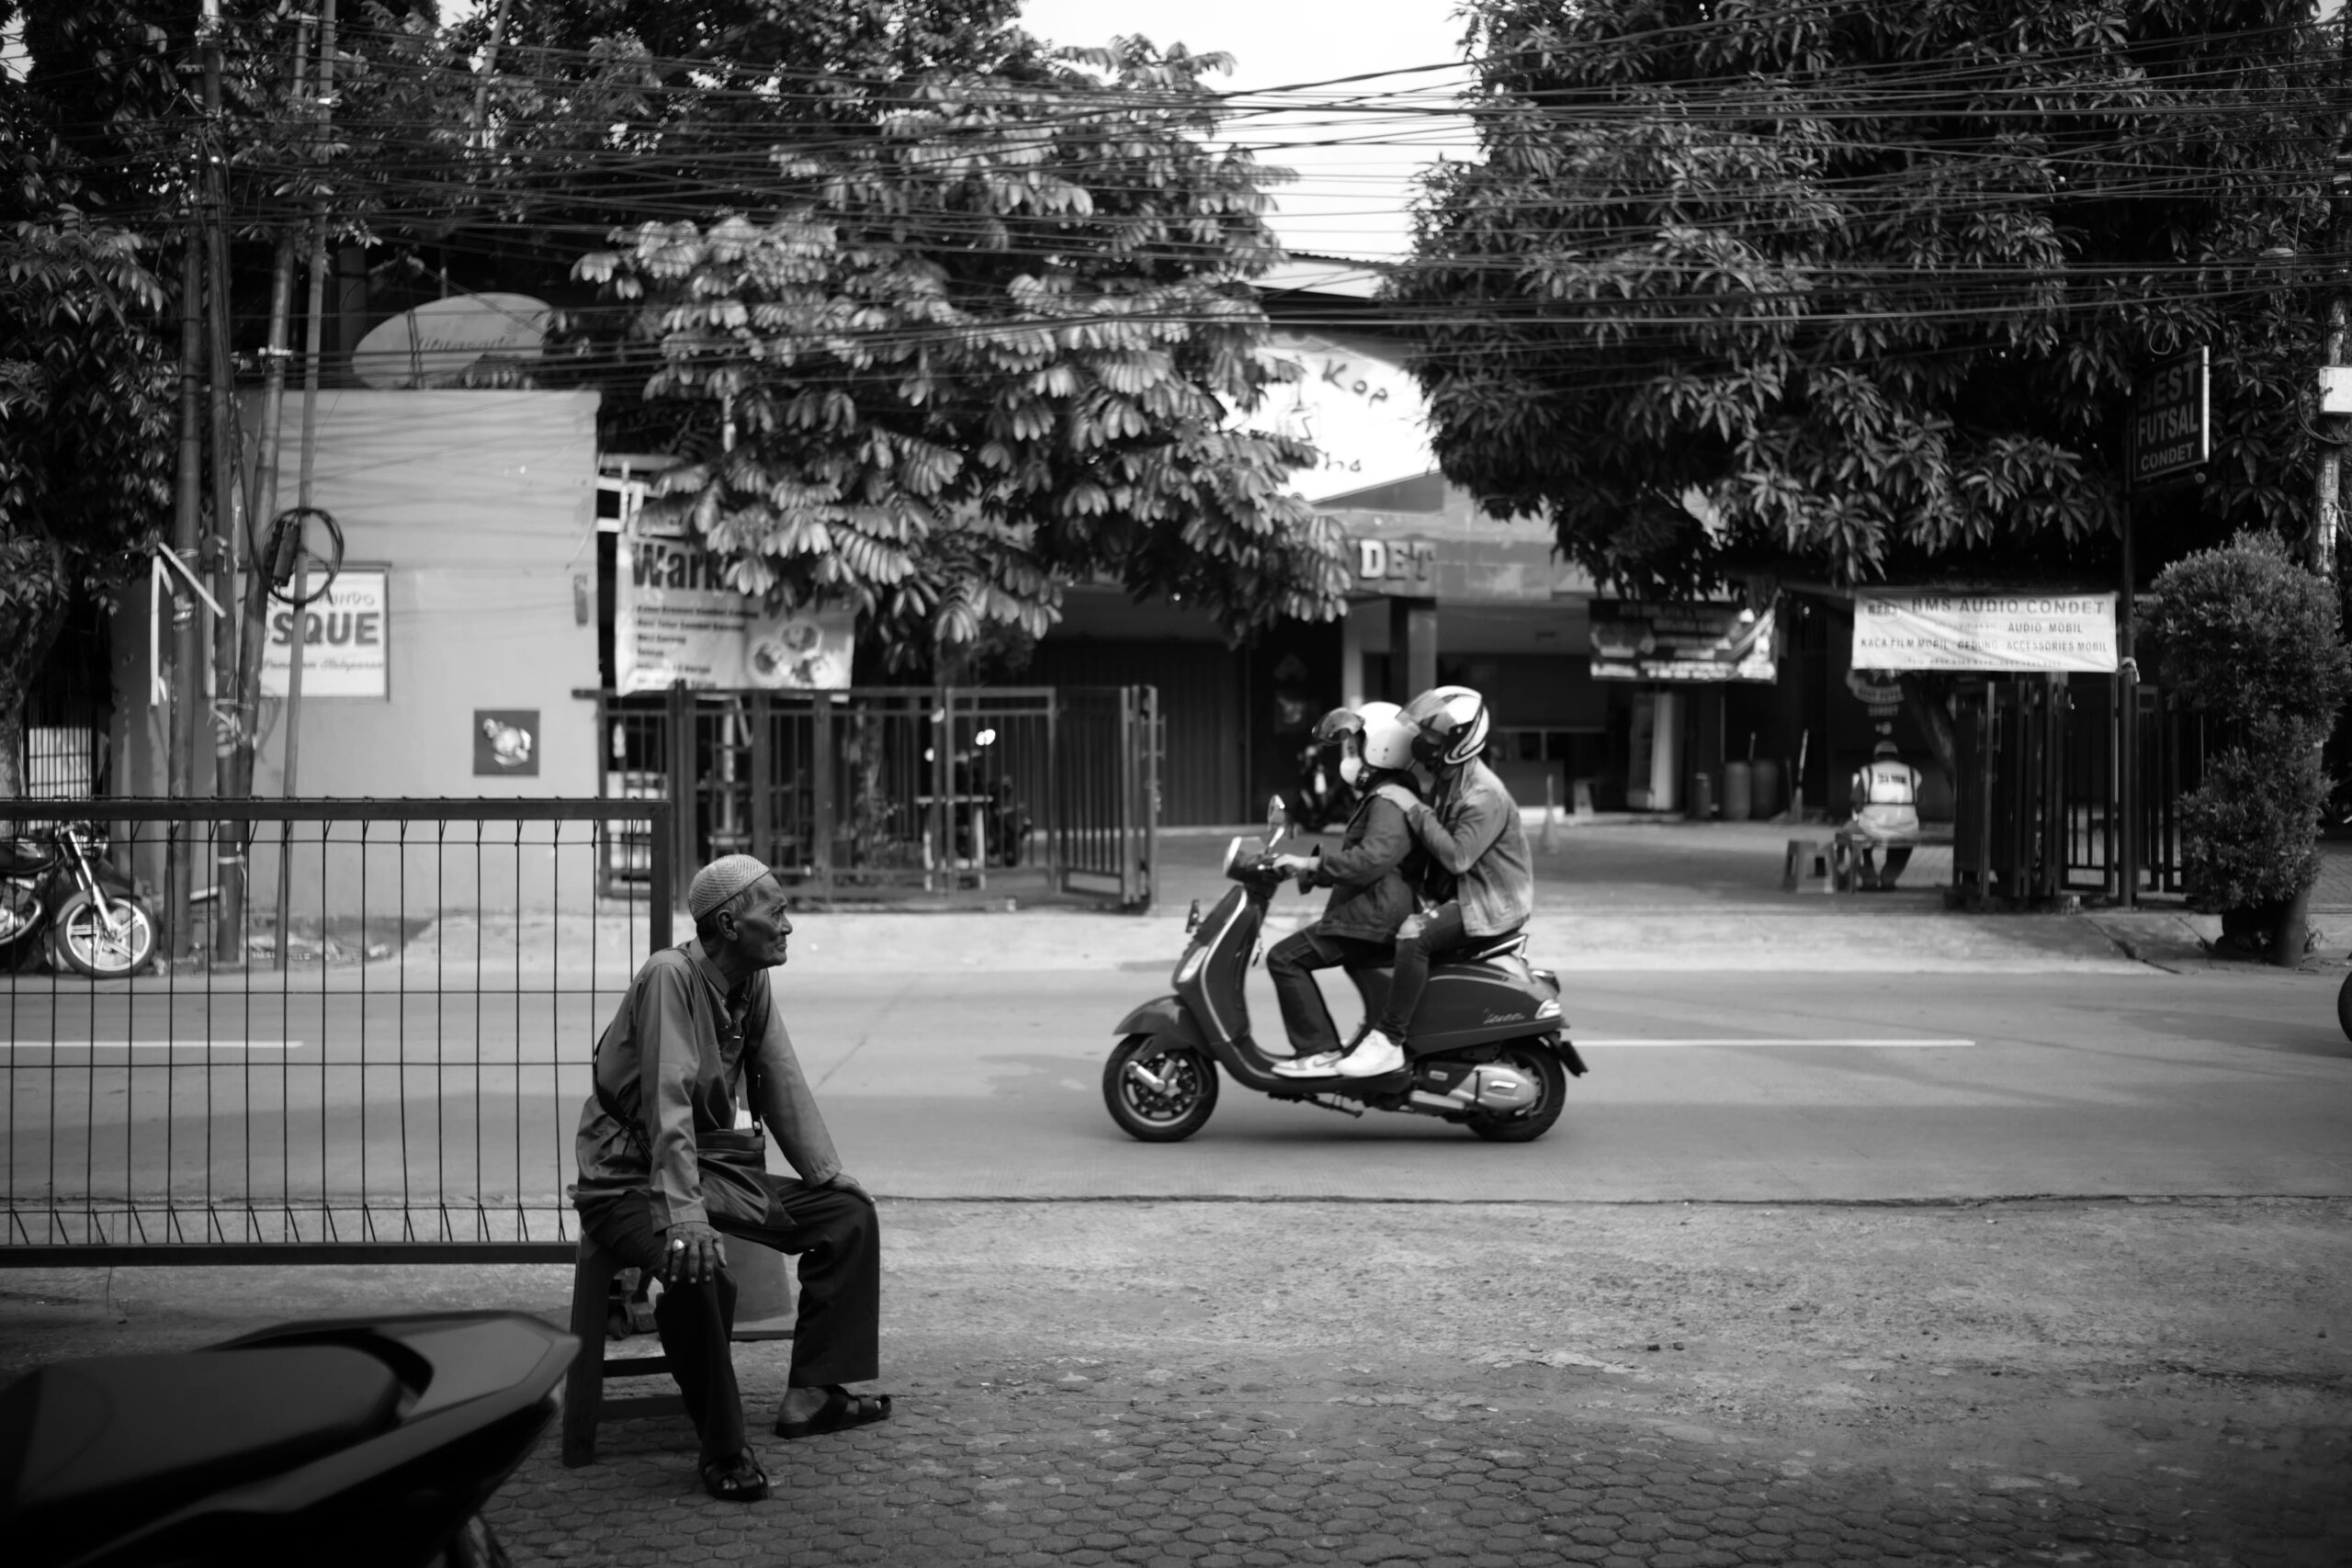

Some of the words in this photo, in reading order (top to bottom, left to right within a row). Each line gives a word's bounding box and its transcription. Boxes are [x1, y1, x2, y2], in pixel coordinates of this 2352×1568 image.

[2138, 362, 2199, 411] BEST
[2138, 402, 2199, 447] FUTSAL
[2141, 442, 2195, 471] CONDET
[632, 543, 724, 590] Wark
[1359, 538, 1437, 581] DET
[1959, 599, 2018, 615] AUDIO
[2026, 600, 2105, 615] CONDET
[266, 612, 379, 646] SQUE
[2007, 623, 2042, 634] AUDIO
[2049, 623, 2083, 634] MOBIL
[1917, 639, 1948, 650] MOBIL
[2007, 640, 2074, 652] ACCESSORIES
[2077, 641, 2108, 653] MOBIL
